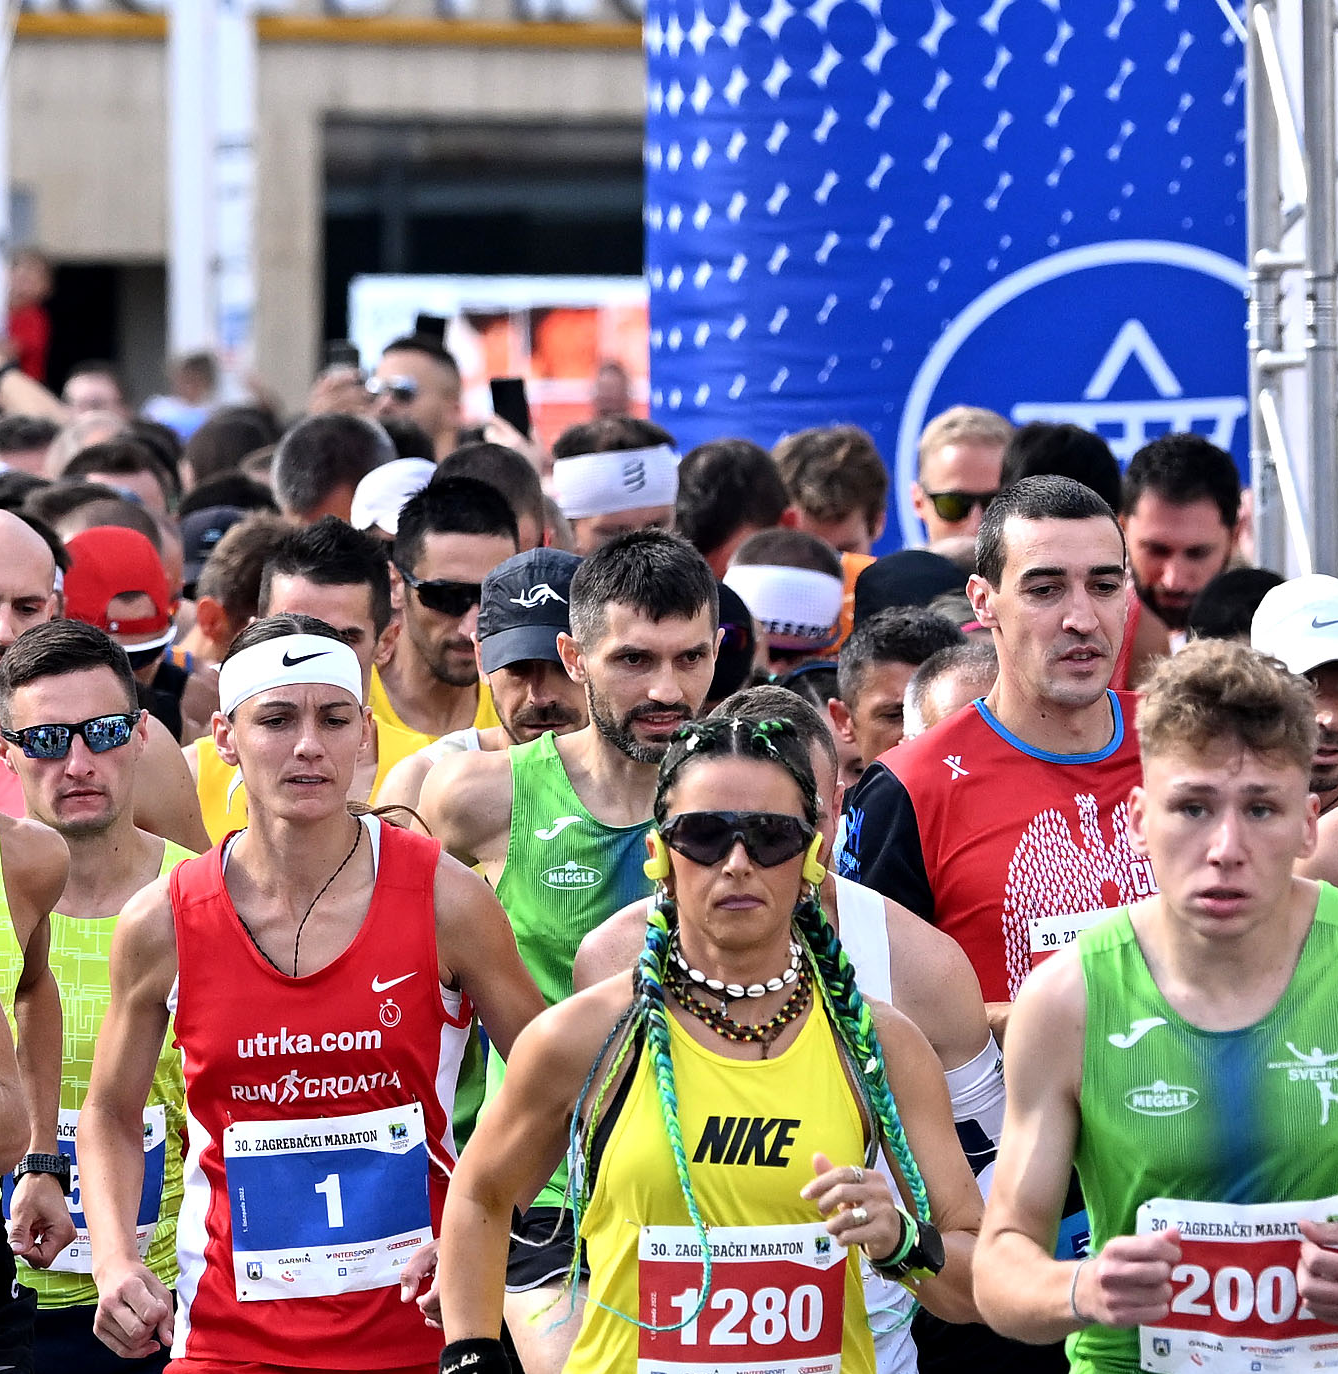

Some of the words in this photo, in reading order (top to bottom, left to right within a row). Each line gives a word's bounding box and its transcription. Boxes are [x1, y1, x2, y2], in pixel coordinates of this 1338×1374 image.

[548, 872, 595, 883] MEGGLE
[1042, 933, 1061, 946] 30.
[237, 1027, 382, 1058] utrka.com
[231, 1082, 277, 1103] RUN
[304, 1071, 402, 1099] CROATIA
[1132, 1092, 1189, 1108] MEGGLE
[235, 1140, 252, 1151] 30.
[256, 1133, 322, 1151] ZAGREBAČKI
[324, 1130, 378, 1146] MARATON
[692, 1116, 801, 1168] NIKE
[314, 1173, 344, 1228] 1
[1177, 1221, 1251, 1238] ZAGREBAČKI
[278, 1253, 311, 1265] GARMIN
[332, 1247, 376, 1259] INTERSPORT
[651, 1243, 670, 1257] 30.
[750, 1242, 804, 1256] MARATON
[1171, 1263, 1317, 1324] 200
[671, 1284, 824, 1346] 1280
